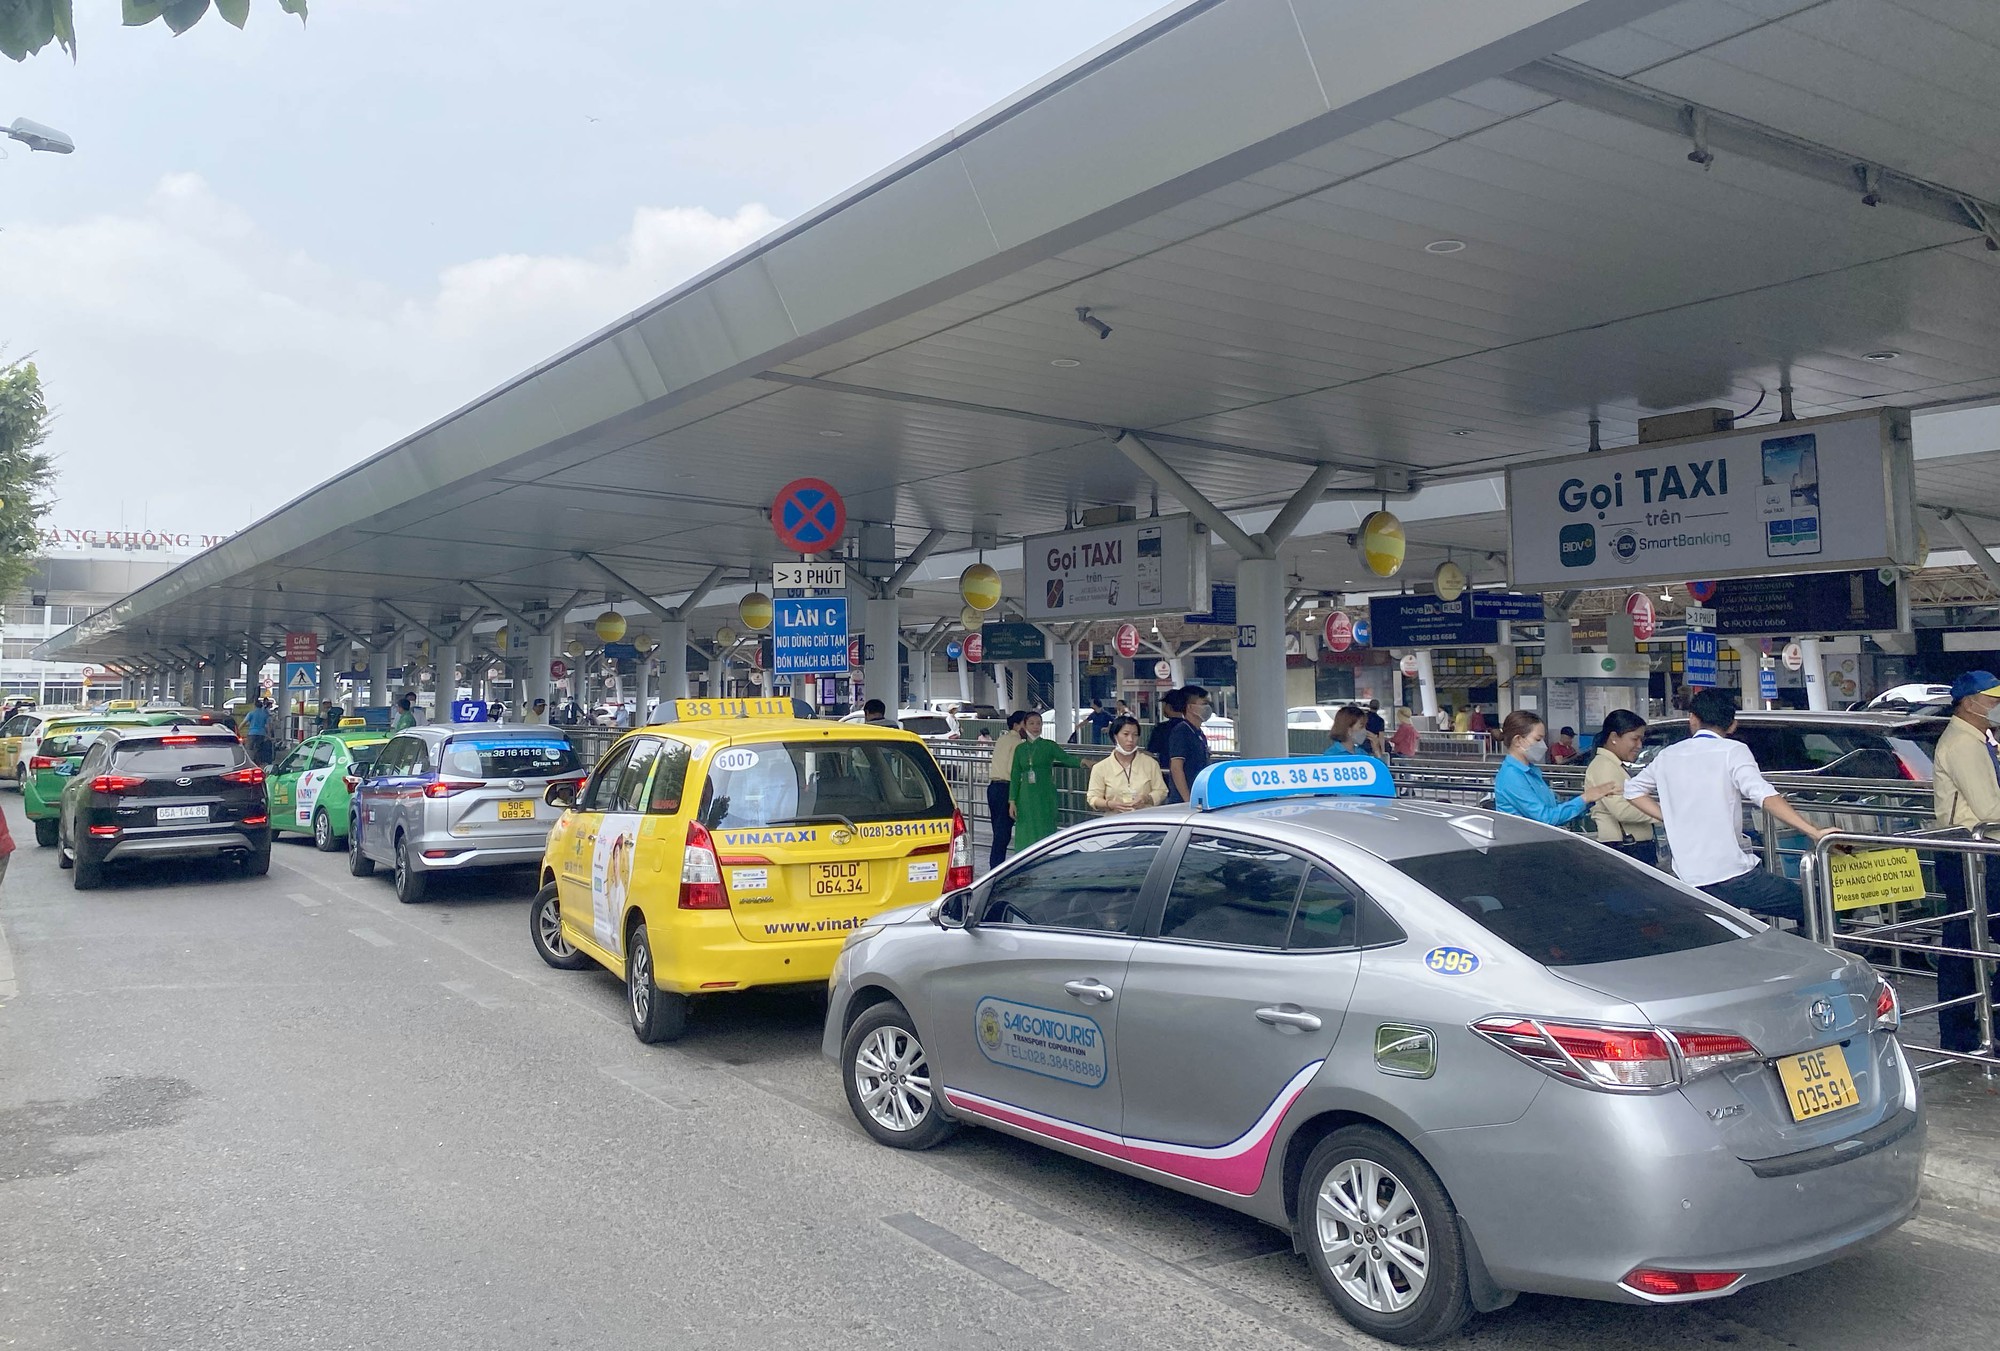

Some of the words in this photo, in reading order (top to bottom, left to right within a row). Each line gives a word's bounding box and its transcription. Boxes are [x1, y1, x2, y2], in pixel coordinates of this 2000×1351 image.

[1558, 472, 1623, 520] Gọi
[1635, 458, 1729, 504] TAXI
[1645, 510, 1681, 526] trên
[106, 529, 190, 547] KHÔNG
[1639, 532, 1731, 551] SmartBanking
[1562, 541, 1585, 553] BIDV
[1047, 546, 1077, 578] Gọi
[1081, 540, 1122, 568] TAXI
[794, 570, 802, 584] 3
[807, 566, 841, 584] PHÚT
[1086, 573, 1103, 583] trên
[784, 604, 818, 627] LÀN
[825, 609, 837, 626] C
[777, 635, 790, 648] NƠI
[791, 633, 812, 648] DỪNG
[814, 632, 829, 647] CHỜ
[830, 634, 845, 650] TẠM
[1237, 627, 1256, 646] -05
[1691, 636, 1705, 653] LÀN
[1708, 641, 1713, 653] B
[776, 653, 792, 668] ĐÓN
[794, 652, 818, 668] KHÁCH
[820, 656, 830, 667] GA
[831, 650, 846, 667] ĐẾN
[461, 703, 479, 720] G7
[686, 702, 712, 717] 38
[717, 701, 749, 716] 111
[755, 700, 786, 715] 111
[493, 749, 505, 757] 38
[506, 749, 517, 757] 16
[519, 749, 530, 757] 16
[719, 751, 753, 768] 6007
[1252, 771, 1285, 785] 028.
[1290, 769, 1307, 783] 38
[1312, 768, 1330, 782] 45
[1334, 766, 1368, 781] 8888
[502, 810, 531, 818] 089.25
[508, 802, 524, 810] 50E
[725, 830, 817, 846] VINATAXI
[822, 864, 857, 878] 50LD
[1875, 858, 1886, 867] VUI
[1900, 869, 1915, 878] TAXI
[816, 879, 863, 894] 064.34
[1837, 892, 1859, 902] Please
[1861, 890, 1880, 900] queue
[1881, 889, 1890, 897] up
[1902, 885, 1915, 893] taxi
[1431, 950, 1474, 973] 595
[1004, 1011, 1097, 1048] SAIGONTOURIST
[1013, 1034, 1047, 1047] TRANSPORT
[1048, 1041, 1086, 1056] COPORATION
[1799, 1051, 1830, 1082] 50E
[1797, 1078, 1851, 1115] 035.91
